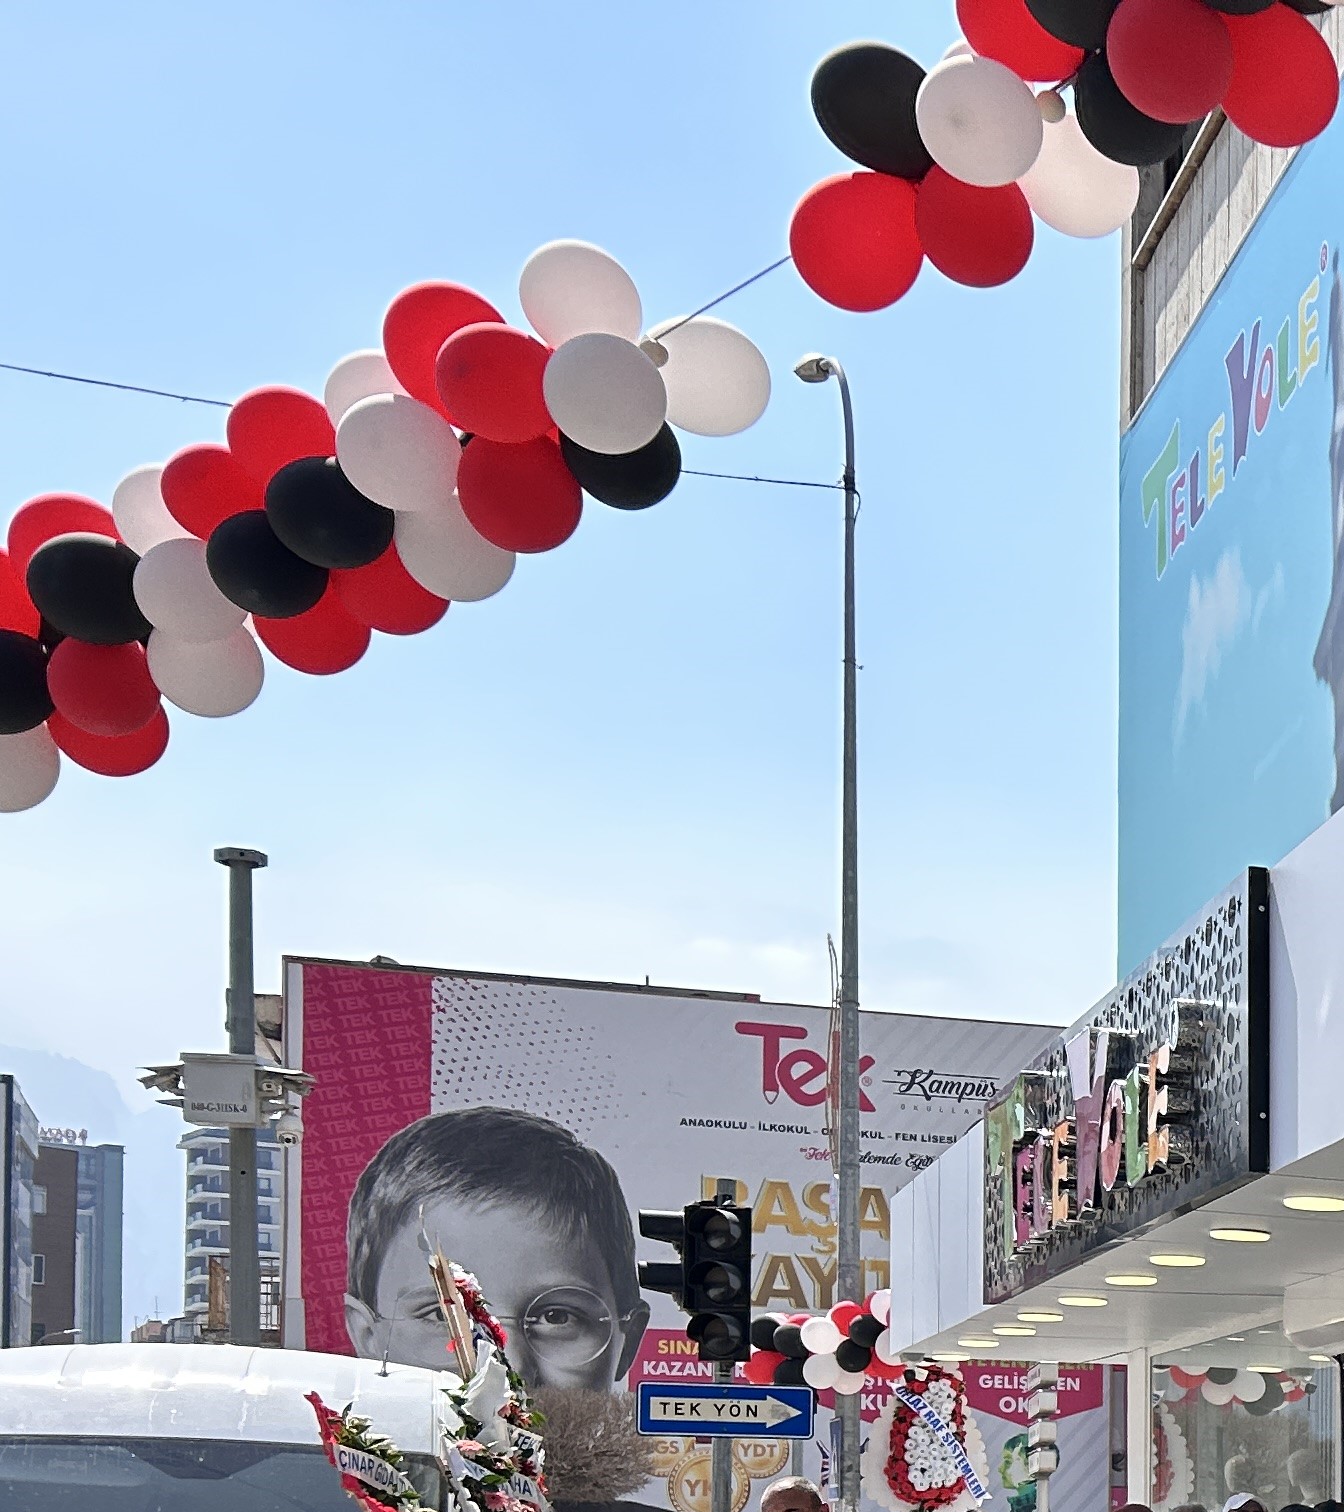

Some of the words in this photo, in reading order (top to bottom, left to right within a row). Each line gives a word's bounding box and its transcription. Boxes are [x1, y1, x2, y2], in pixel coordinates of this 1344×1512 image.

[1141, 275, 1320, 581] TELEVOLE
[894, 1069, 999, 1102] Kampüs
[680, 1117, 747, 1130] ANAOKULU
[758, 1121, 811, 1135] İLKOKUL
[895, 1132, 918, 1142] FEN
[920, 1132, 957, 1144] LİSESİ
[659, 1402, 701, 1416] TEK
[713, 1400, 758, 1417] YÖN
[339, 1450, 375, 1479] ÇINAR
[740, 1443, 778, 1459] YDT
